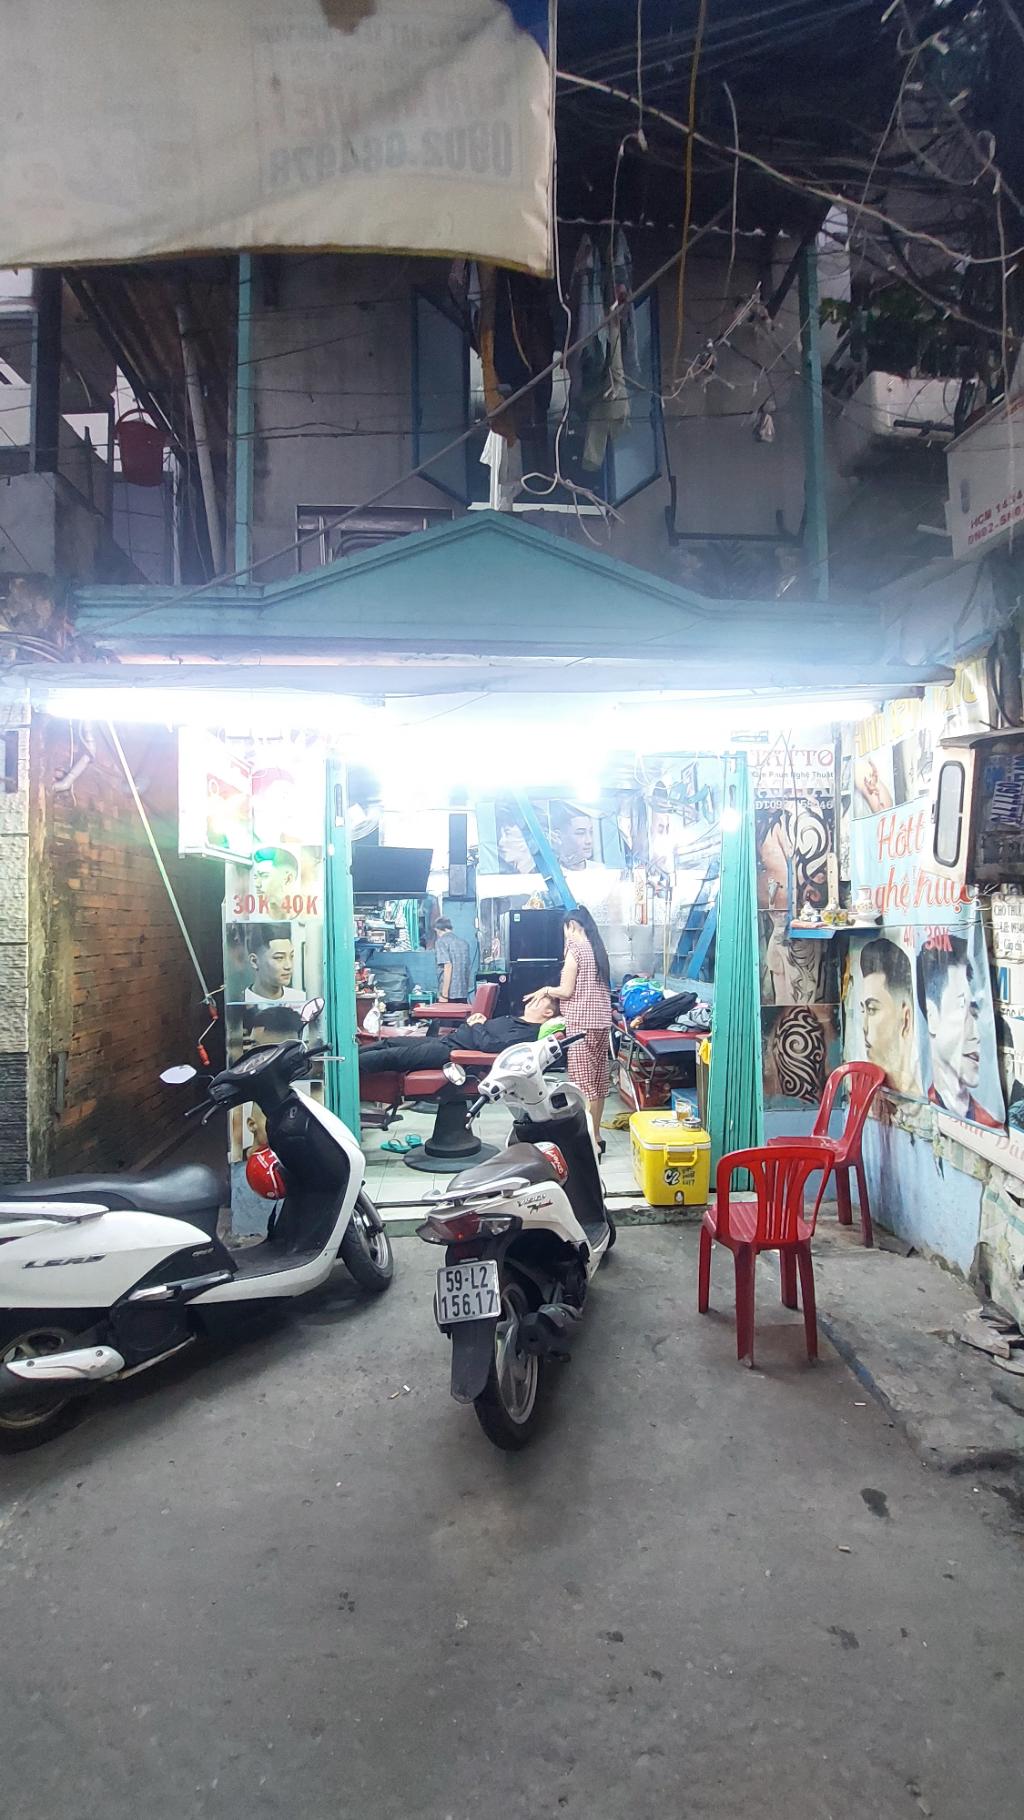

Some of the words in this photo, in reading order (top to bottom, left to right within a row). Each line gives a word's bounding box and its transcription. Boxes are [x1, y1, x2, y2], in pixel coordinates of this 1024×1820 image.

[233, 894, 271, 915] 30K
[280, 894, 319, 915] 40K
[22, 1253, 107, 1269] LEAD
[446, 1266, 488, 1293] 59-L2
[441, 1289, 495, 1319] 156.17
